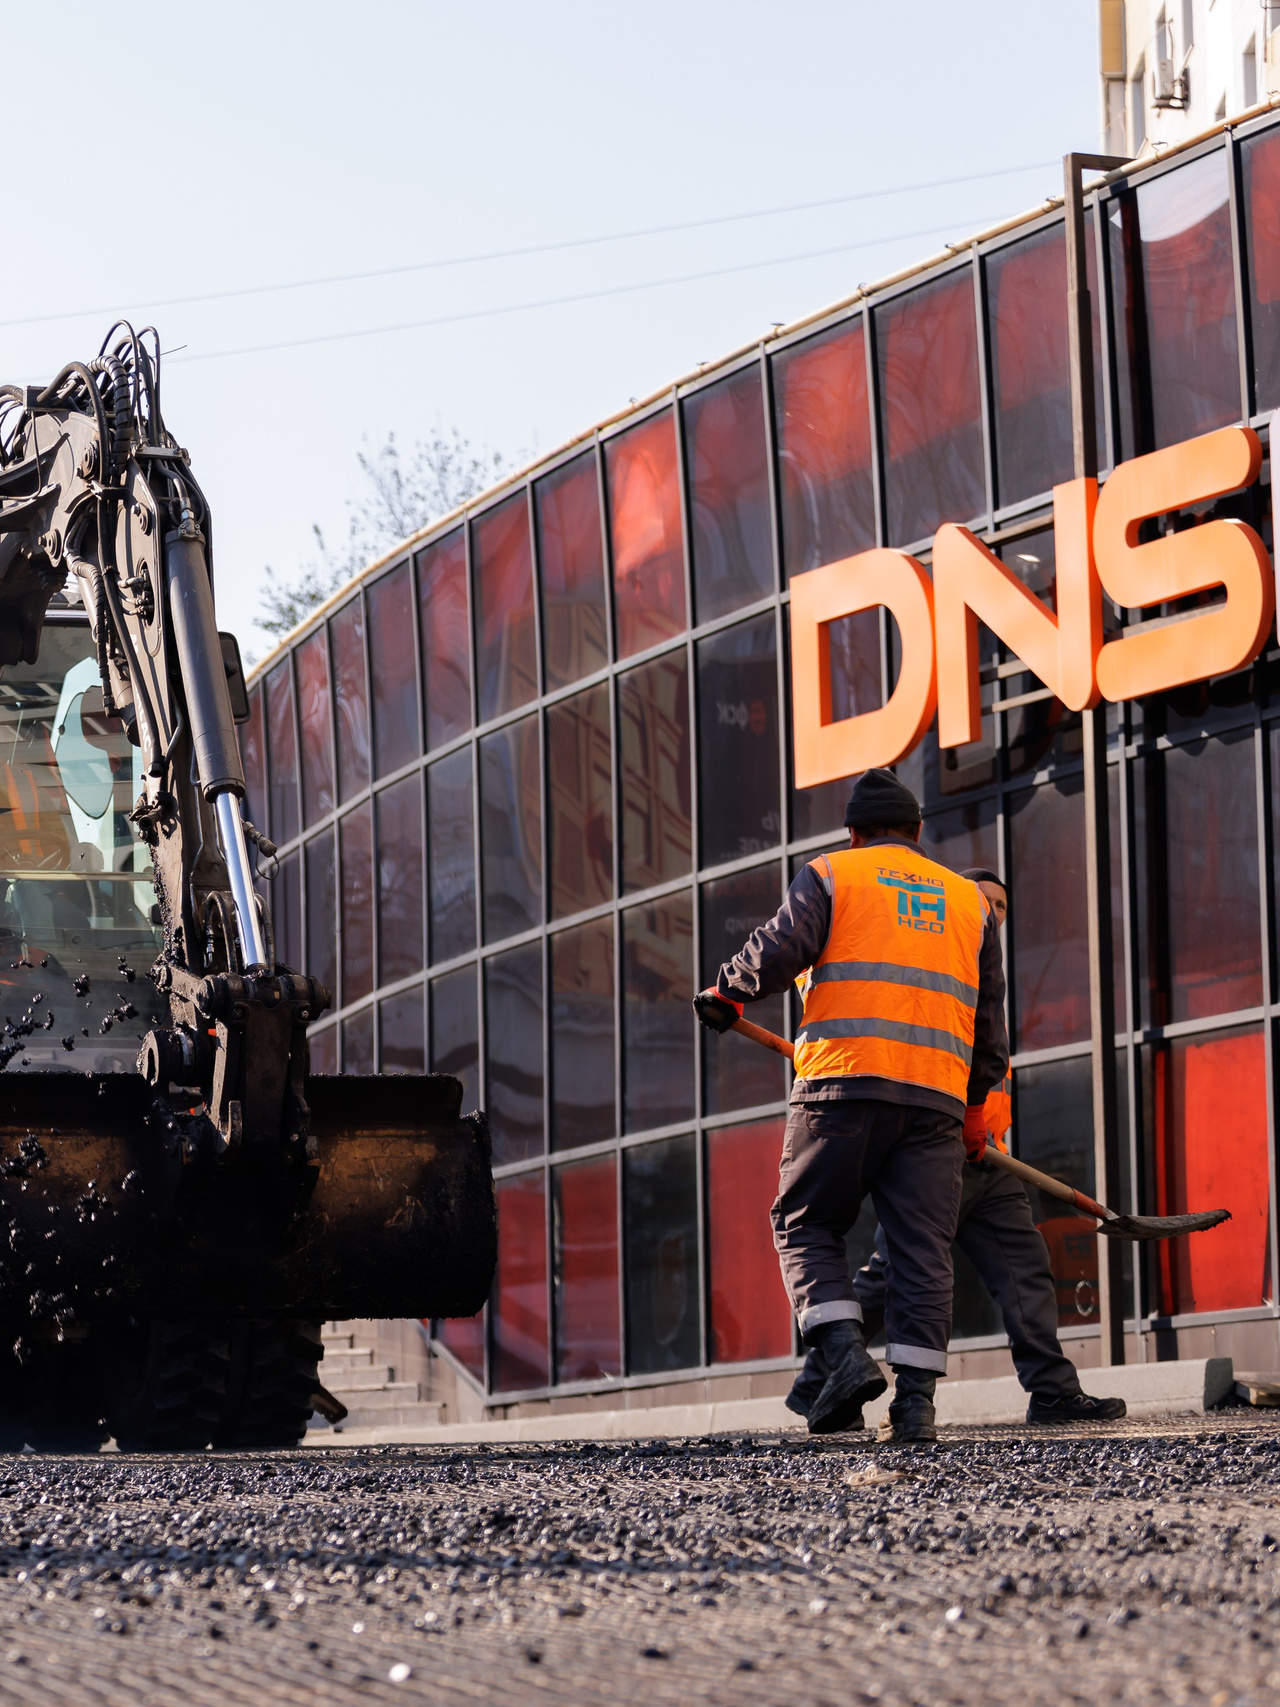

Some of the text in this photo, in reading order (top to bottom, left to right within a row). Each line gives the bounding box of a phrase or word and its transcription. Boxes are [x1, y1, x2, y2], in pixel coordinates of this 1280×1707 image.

[790, 426, 1274, 789] DNS
[875, 866, 944, 887] ТЕХНО
[898, 915, 945, 935] НЕО
